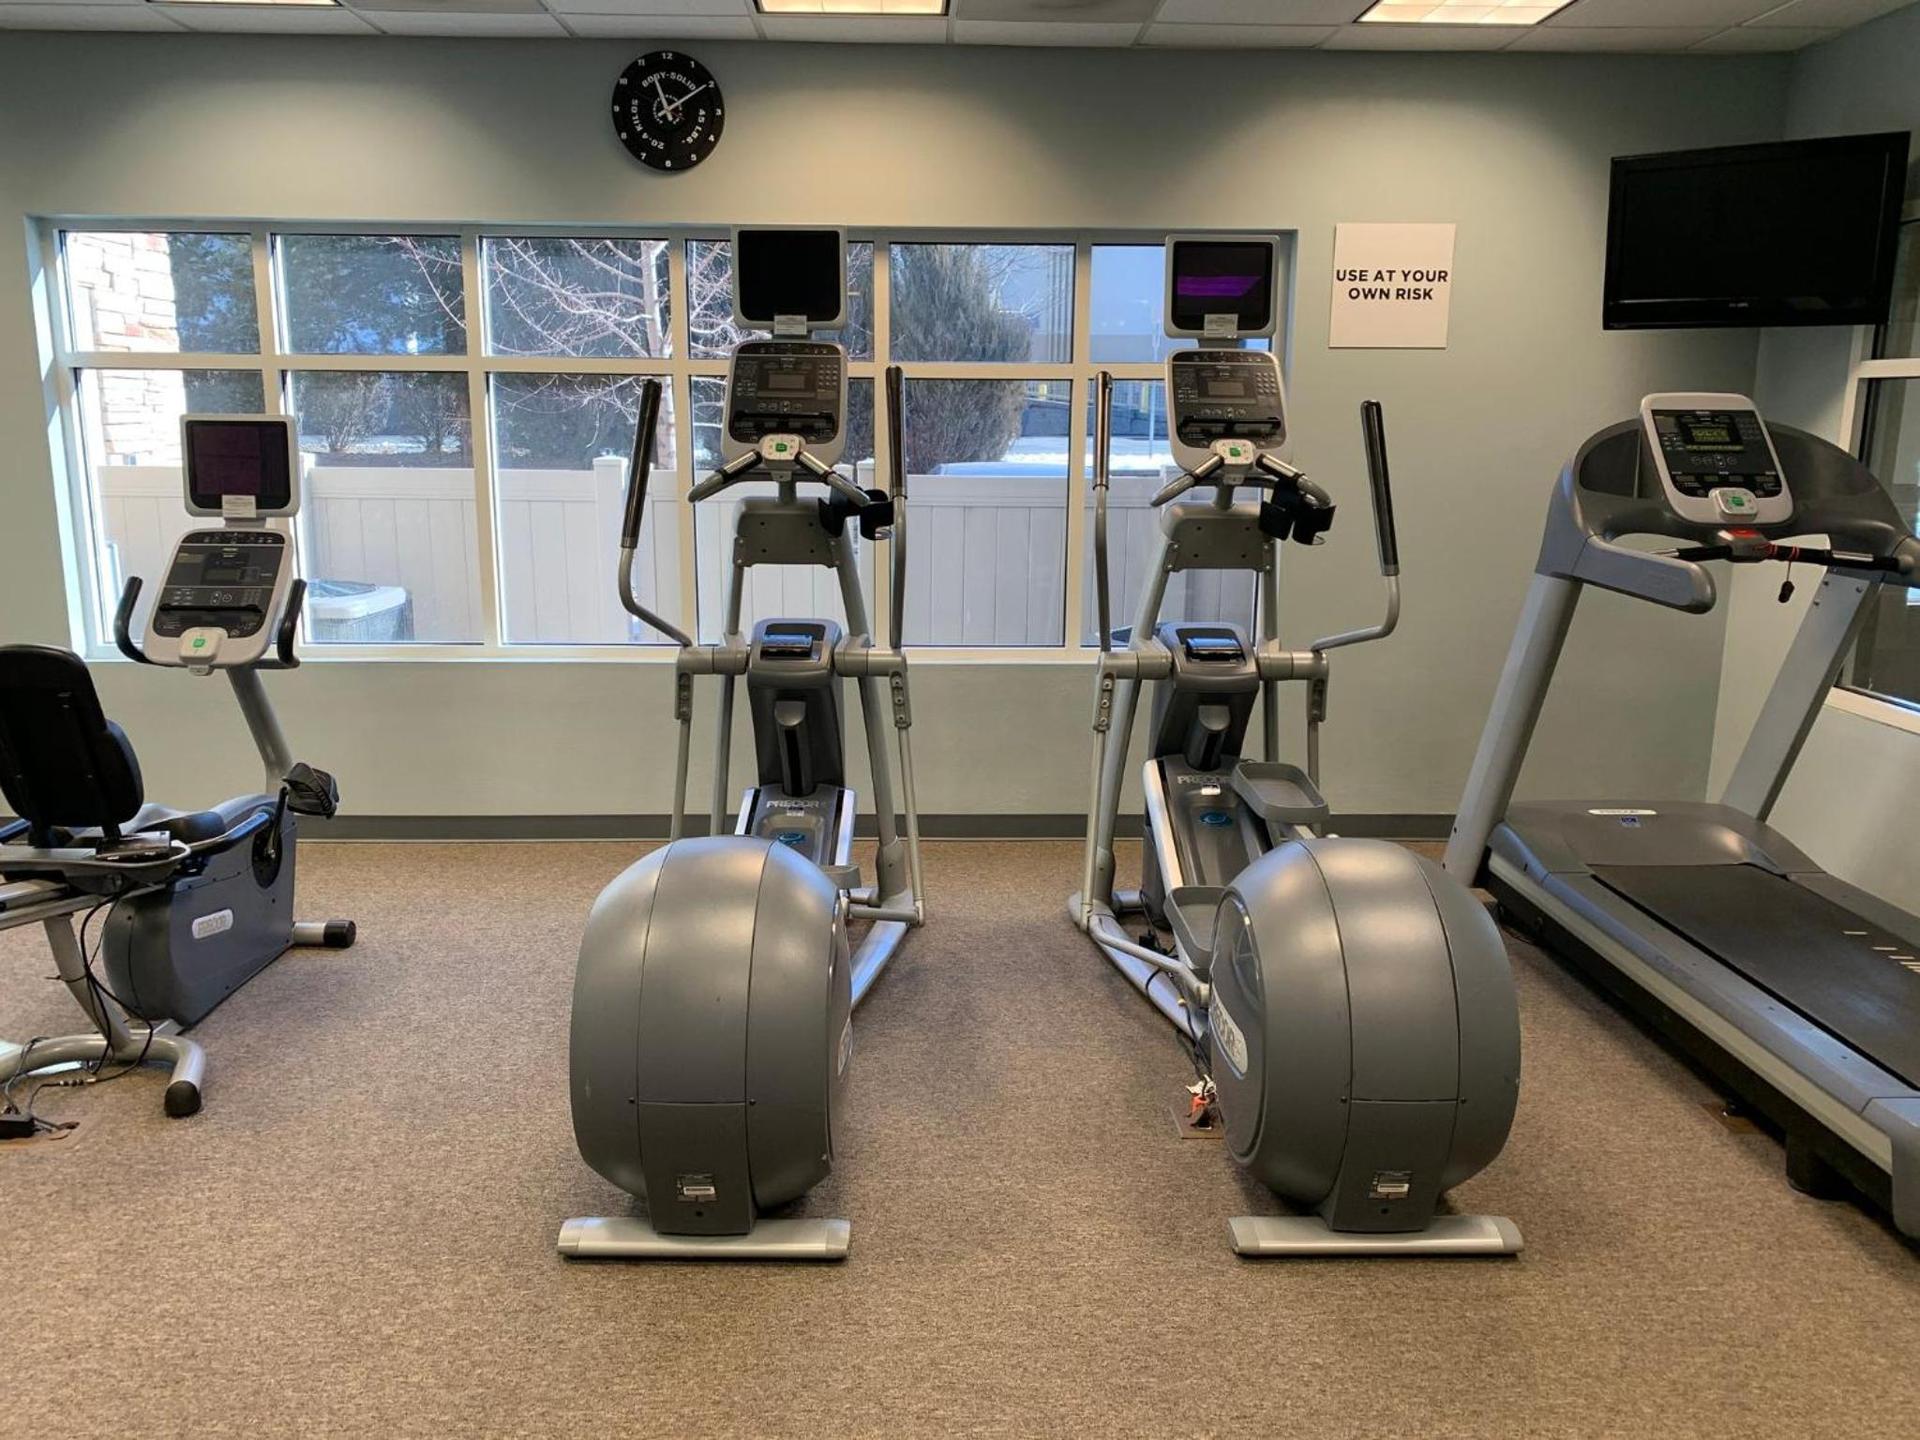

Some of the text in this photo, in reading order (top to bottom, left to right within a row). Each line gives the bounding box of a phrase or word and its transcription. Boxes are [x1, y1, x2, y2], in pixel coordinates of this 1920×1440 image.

[662, 52, 673, 60] 12
[707, 80, 715, 88] 2
[715, 108, 722, 116] 3
[708, 134, 715, 142] 4
[640, 152, 647, 160] 7
[690, 153, 697, 161] 5
[664, 160, 672, 168] 6
[1336, 269, 1449, 283] USE AT YOUR
[1348, 287, 1434, 300] OWN RISK
